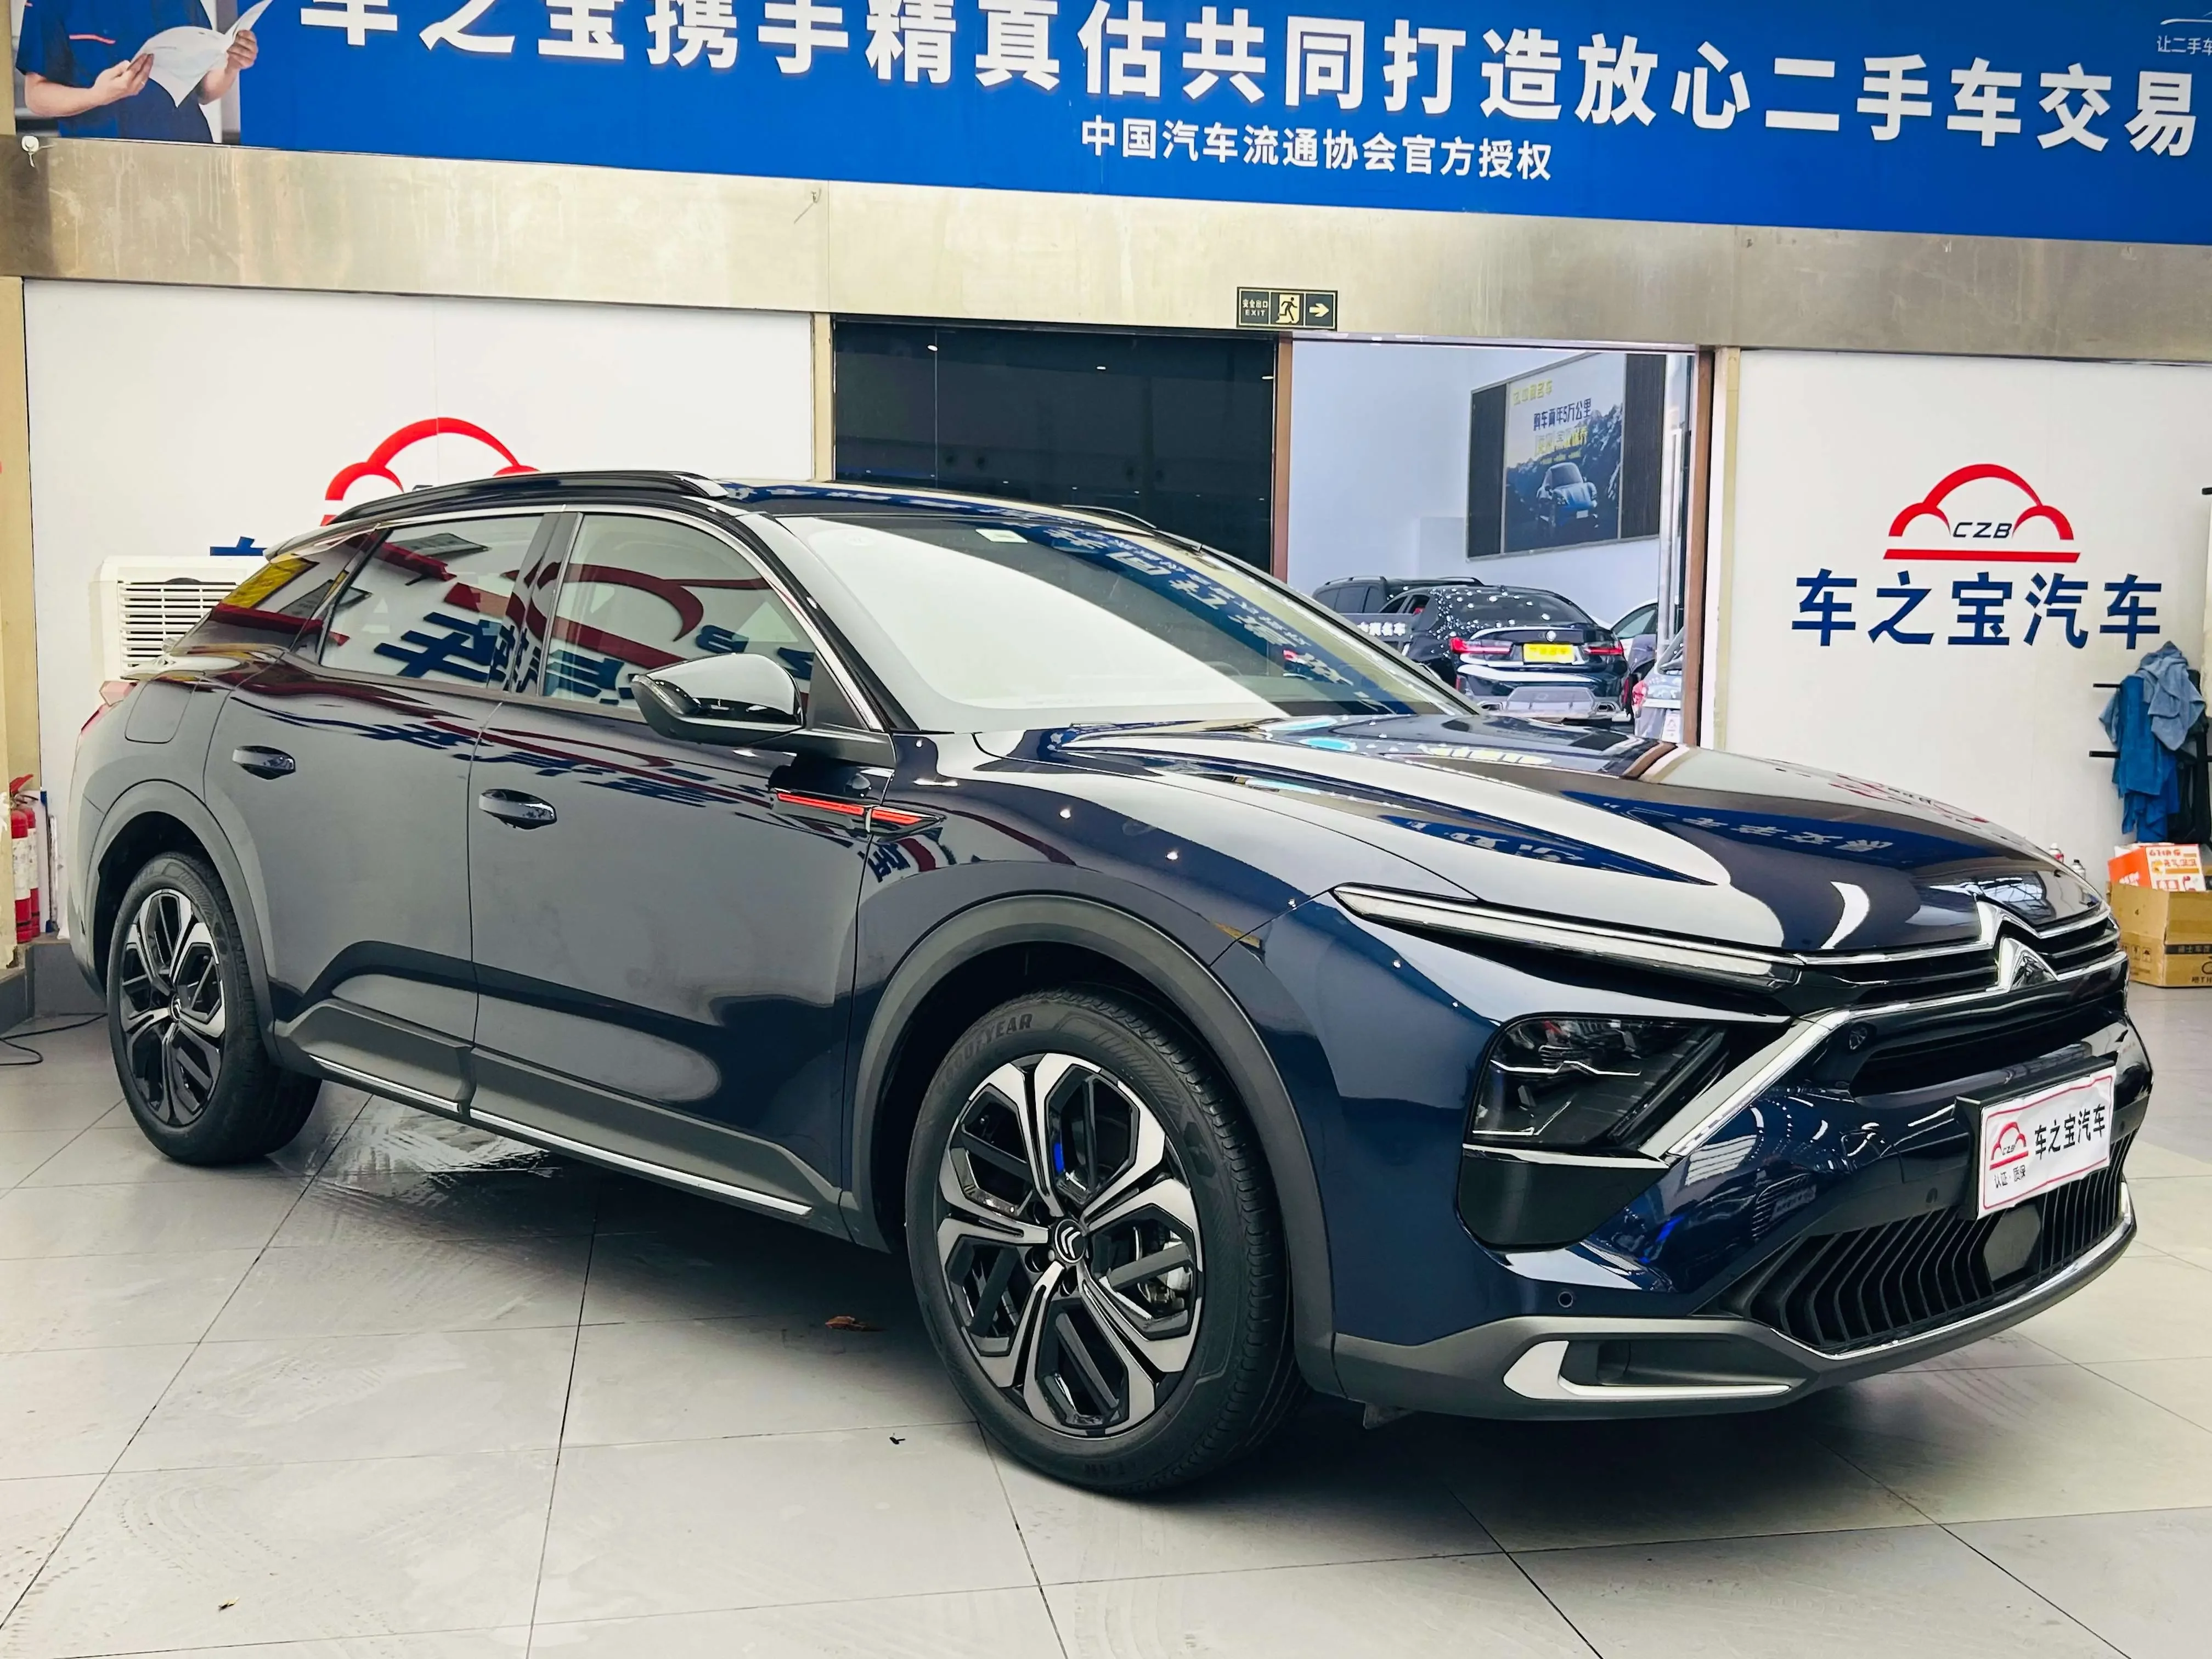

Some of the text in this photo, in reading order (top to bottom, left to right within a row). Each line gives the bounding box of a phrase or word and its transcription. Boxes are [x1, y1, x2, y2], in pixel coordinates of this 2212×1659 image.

[1081, 114, 1552, 182] 中国汽车流通协会官方授权
[1953, 522, 2012, 539] CZB
[1791, 568, 2162, 650] 车之宝汽车
[2034, 1104, 2106, 1160] 车之宝汽车
